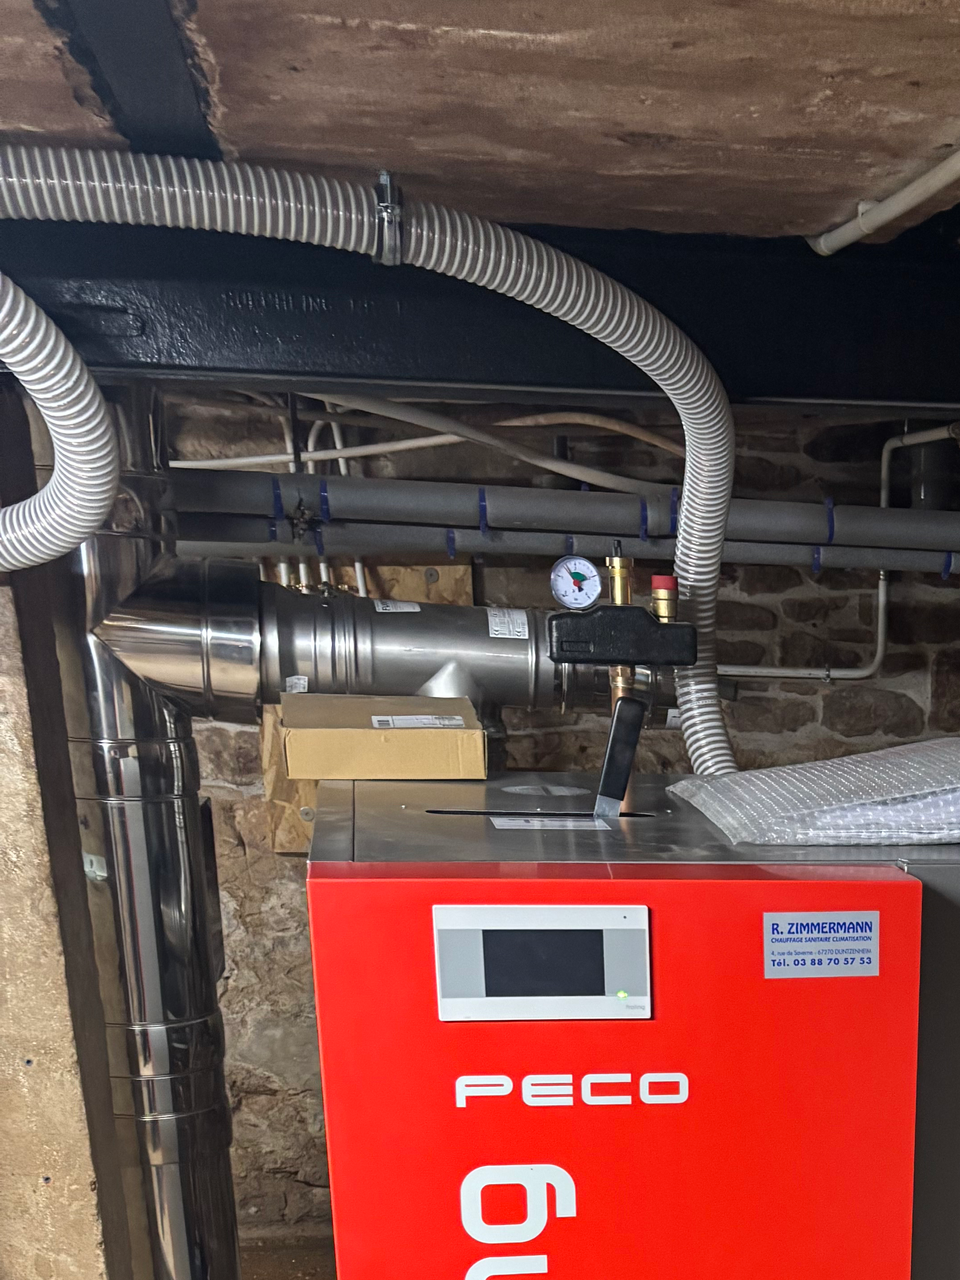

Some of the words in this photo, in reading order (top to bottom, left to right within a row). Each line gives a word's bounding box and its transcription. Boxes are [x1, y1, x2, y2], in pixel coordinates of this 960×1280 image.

[771, 922, 784, 935] R.
[787, 921, 873, 935] ZIMMERMANN
[770, 958, 790, 967] Tél.
[793, 958, 806, 966] 03
[810, 958, 823, 966] 88
[827, 957, 840, 966] 70
[843, 957, 856, 965] 57
[859, 957, 872, 965] 53
[455, 1072, 690, 1108] PECO
